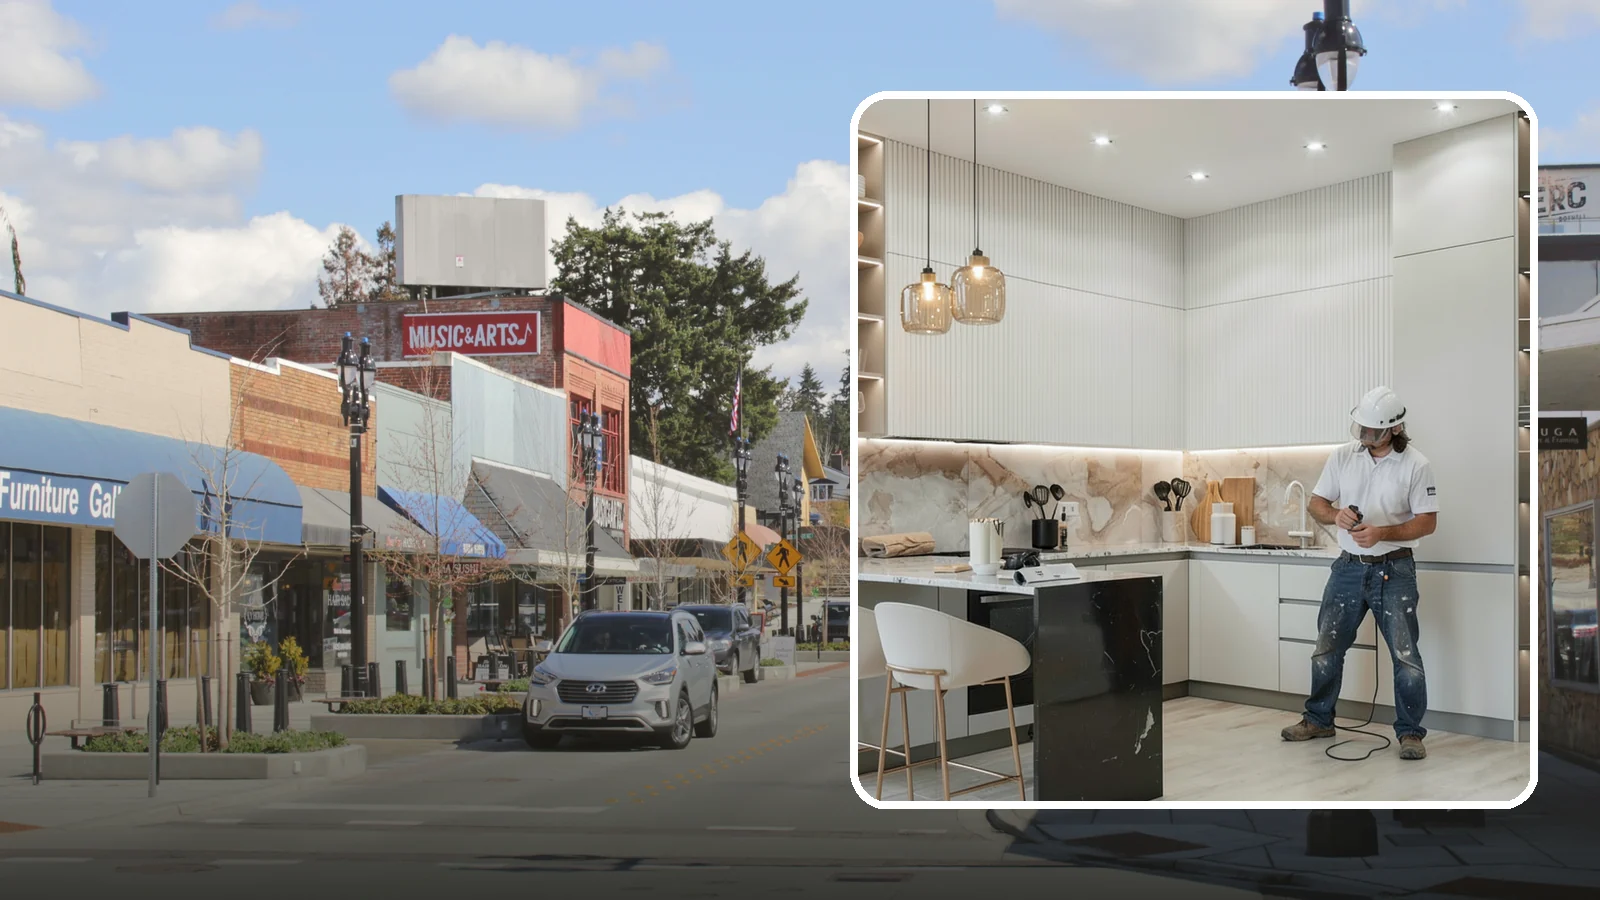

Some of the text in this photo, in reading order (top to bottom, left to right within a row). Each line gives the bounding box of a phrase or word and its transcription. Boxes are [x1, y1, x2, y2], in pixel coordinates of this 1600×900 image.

[1540, 427, 1578, 437] UGA
[0, 471, 79, 516] Furniture
[453, 562, 480, 575] SUSHI
